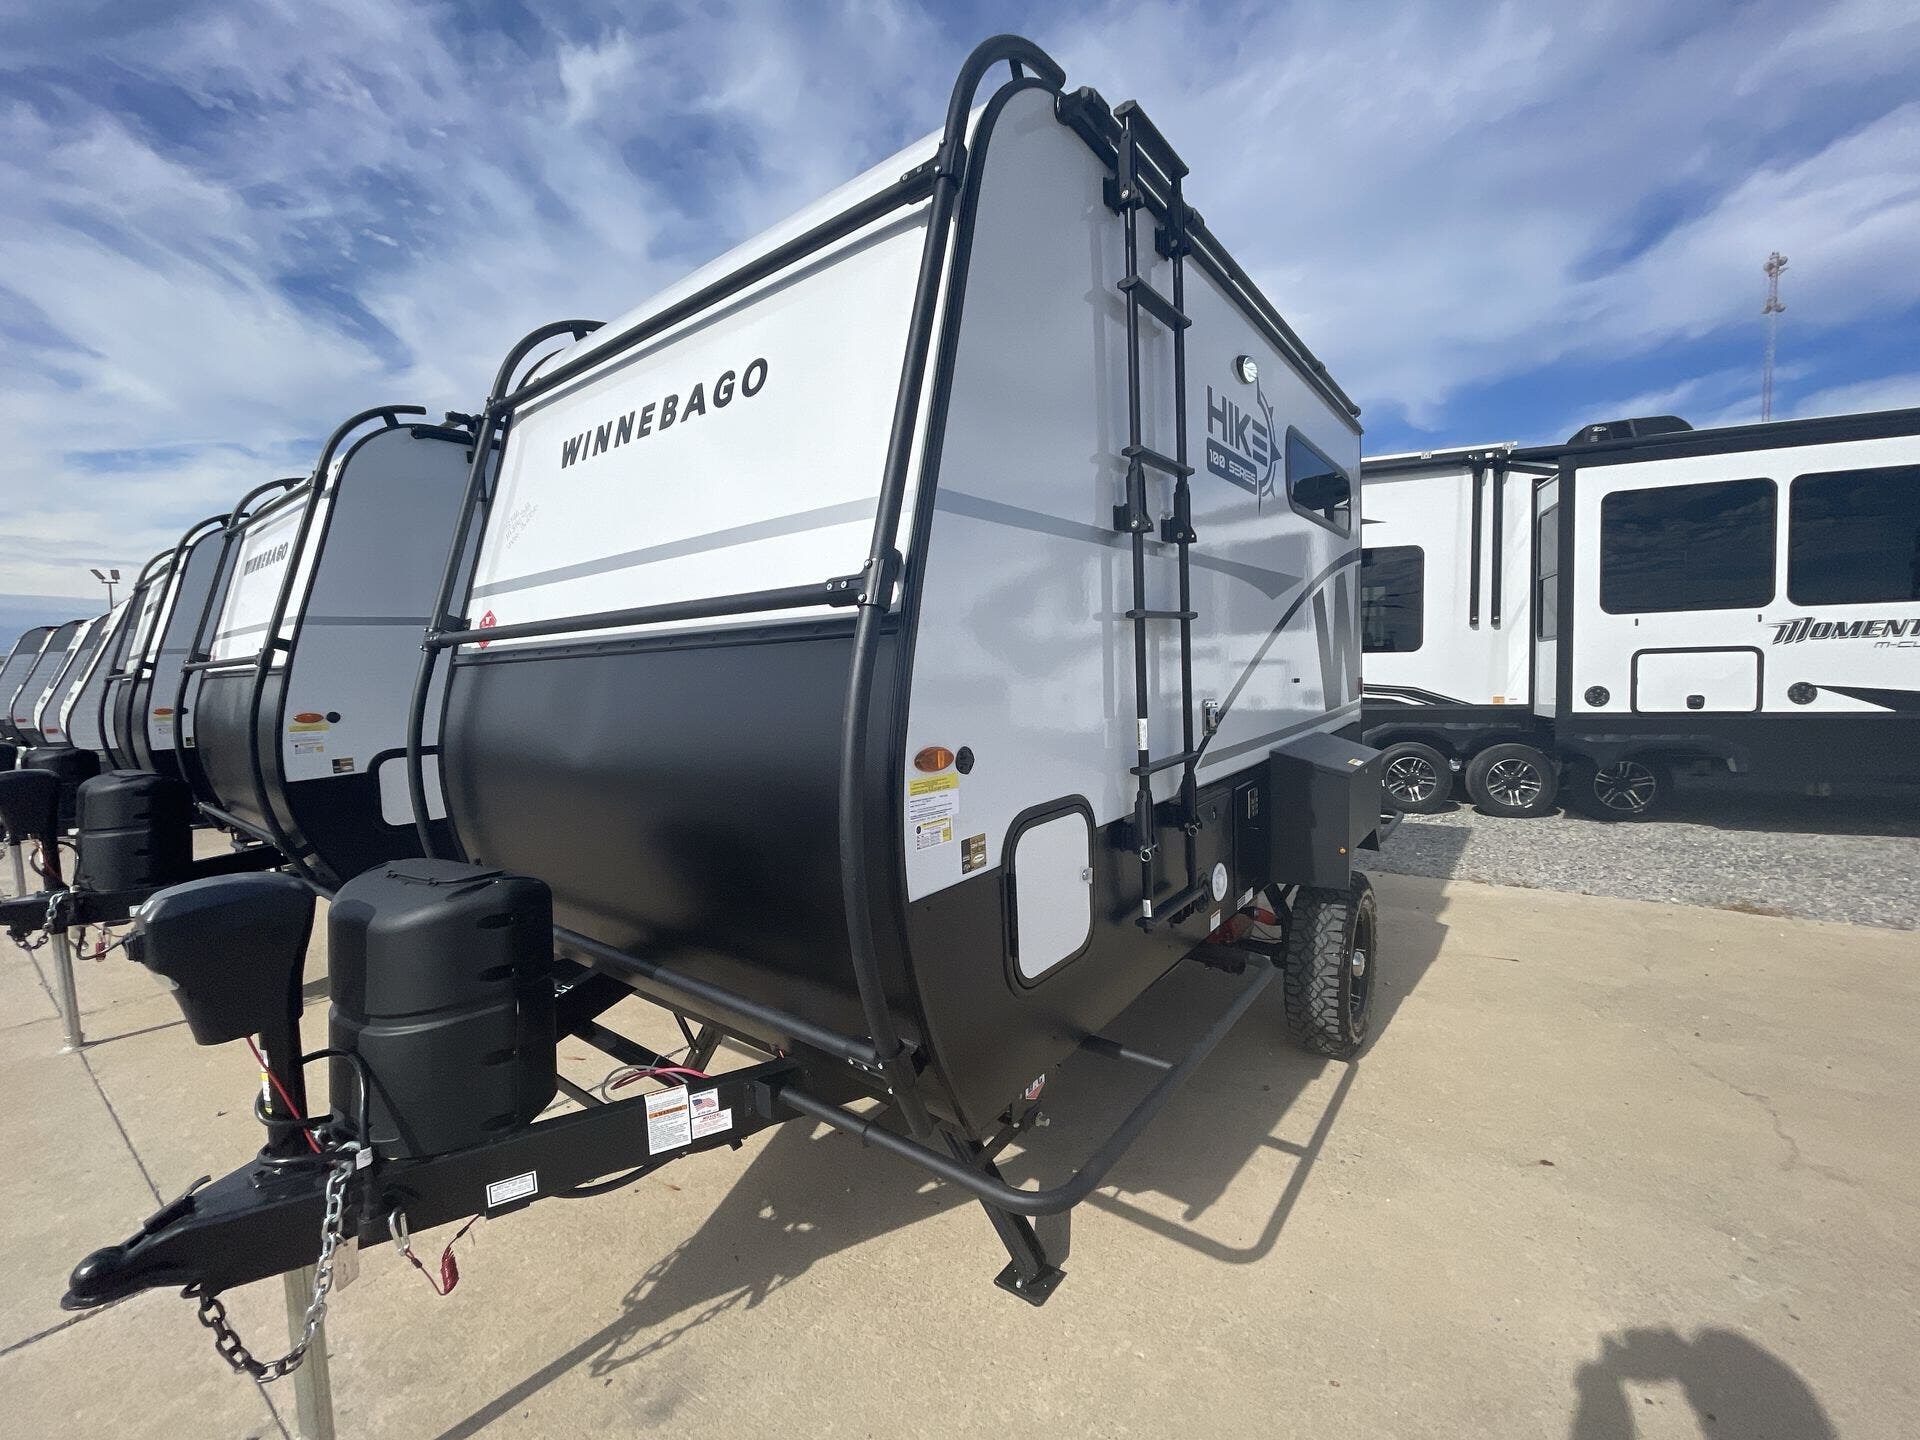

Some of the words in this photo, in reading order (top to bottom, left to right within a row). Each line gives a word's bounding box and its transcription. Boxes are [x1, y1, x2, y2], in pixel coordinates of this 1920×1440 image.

[561, 357, 768, 469] WINNEBAGO
[1207, 385, 1267, 468] HIKE
[1209, 448, 1226, 469] 100
[1228, 460, 1256, 485] SERIES
